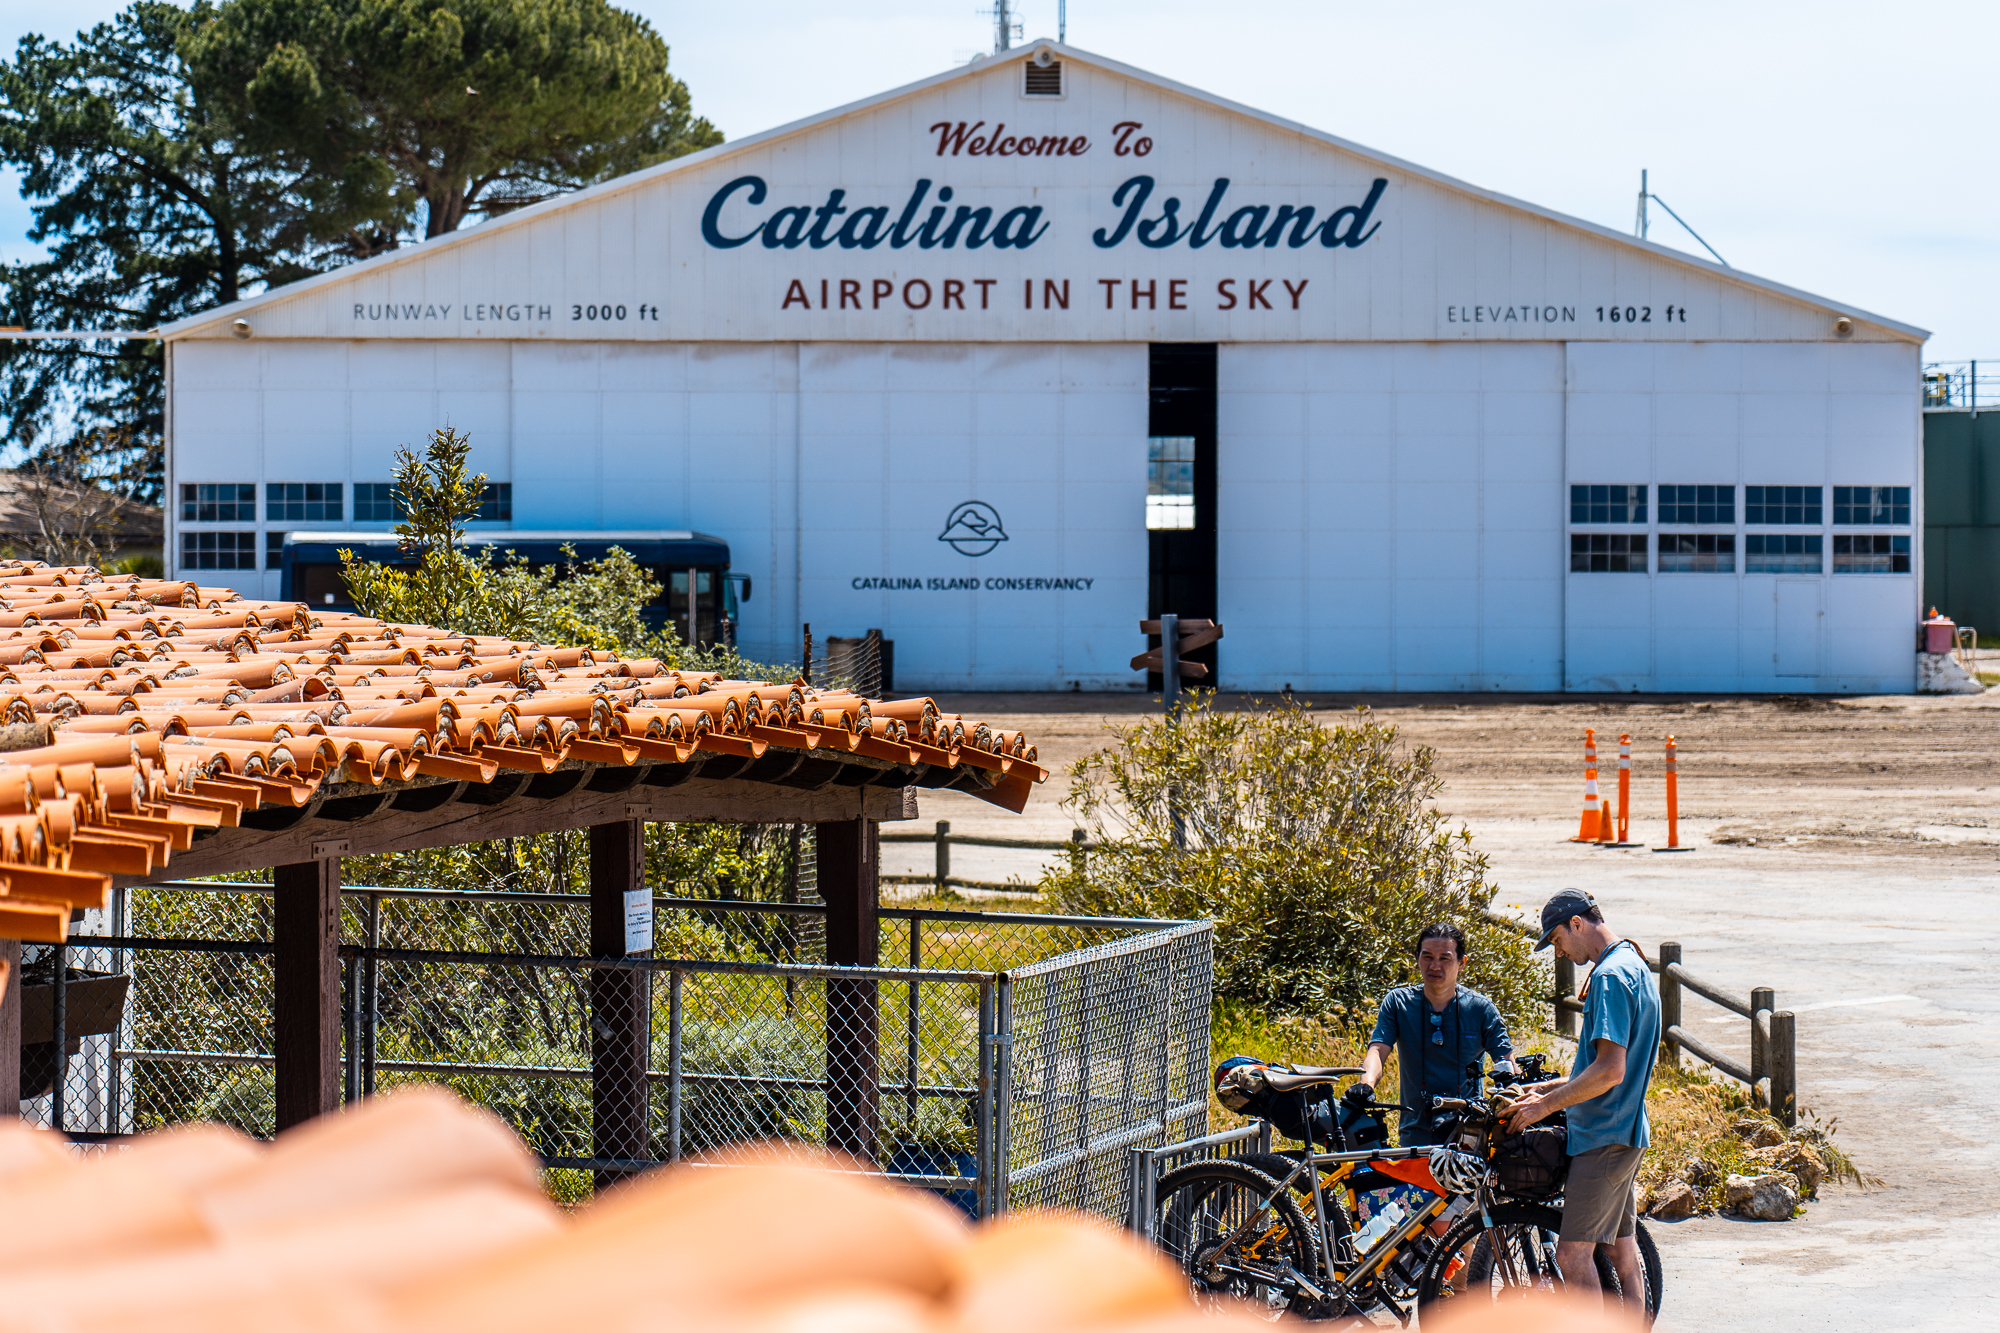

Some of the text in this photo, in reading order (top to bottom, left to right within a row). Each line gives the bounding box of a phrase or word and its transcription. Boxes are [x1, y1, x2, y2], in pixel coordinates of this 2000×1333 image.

[929, 121, 1154, 158] Welcome To
[701, 174, 1388, 250] Catalina Island
[781, 279, 1309, 311] AIRPORT IN THE SKY
[353, 303, 660, 321] RUNWAY LENGTH 3000 ft
[1447, 304, 1687, 323] ELEVATION 1602 ft
[851, 577, 1094, 591] CATALINA ISLAND CONSERVANCY
